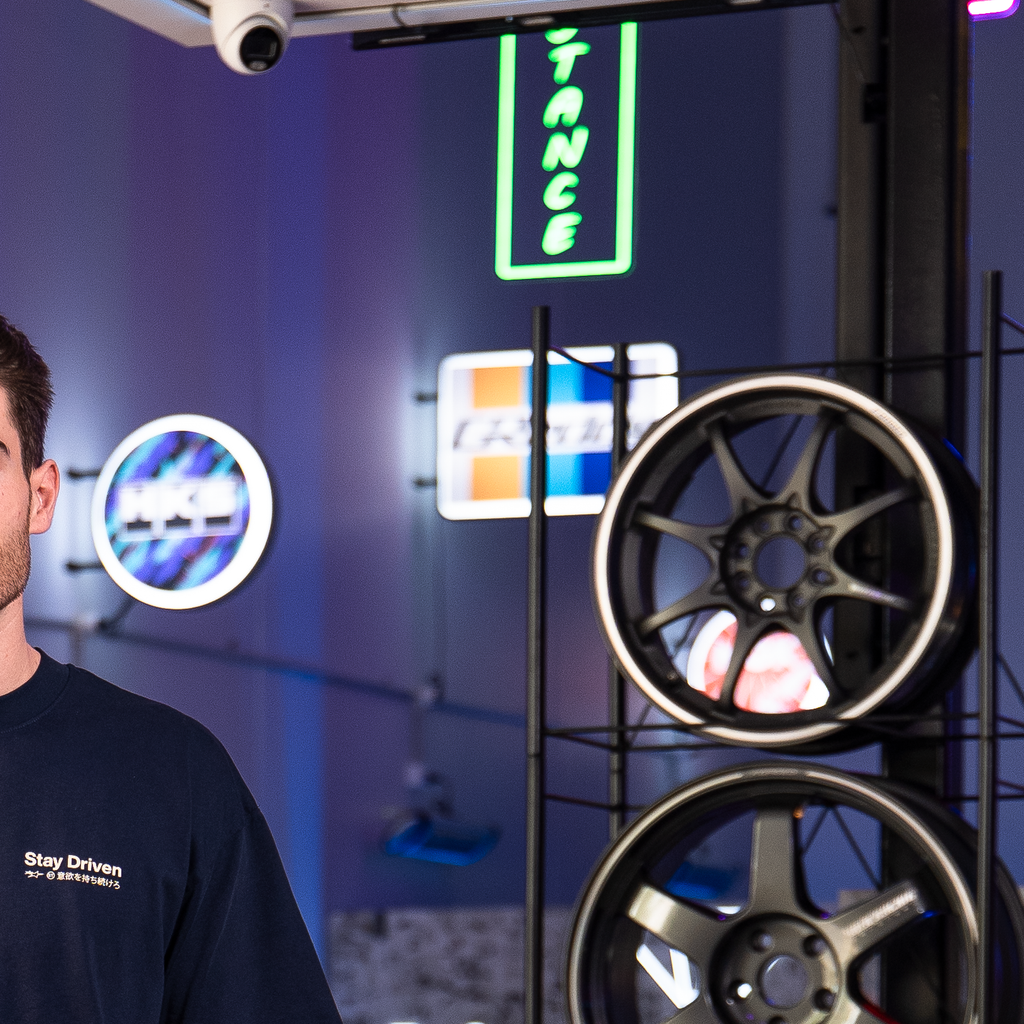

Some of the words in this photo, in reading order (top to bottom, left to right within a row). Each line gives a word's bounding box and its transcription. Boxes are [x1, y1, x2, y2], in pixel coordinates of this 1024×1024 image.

[24, 851, 63, 871] Stay
[67, 854, 123, 878] Driven
[56, 871, 121, 890] 意欲を持ち続けろ
